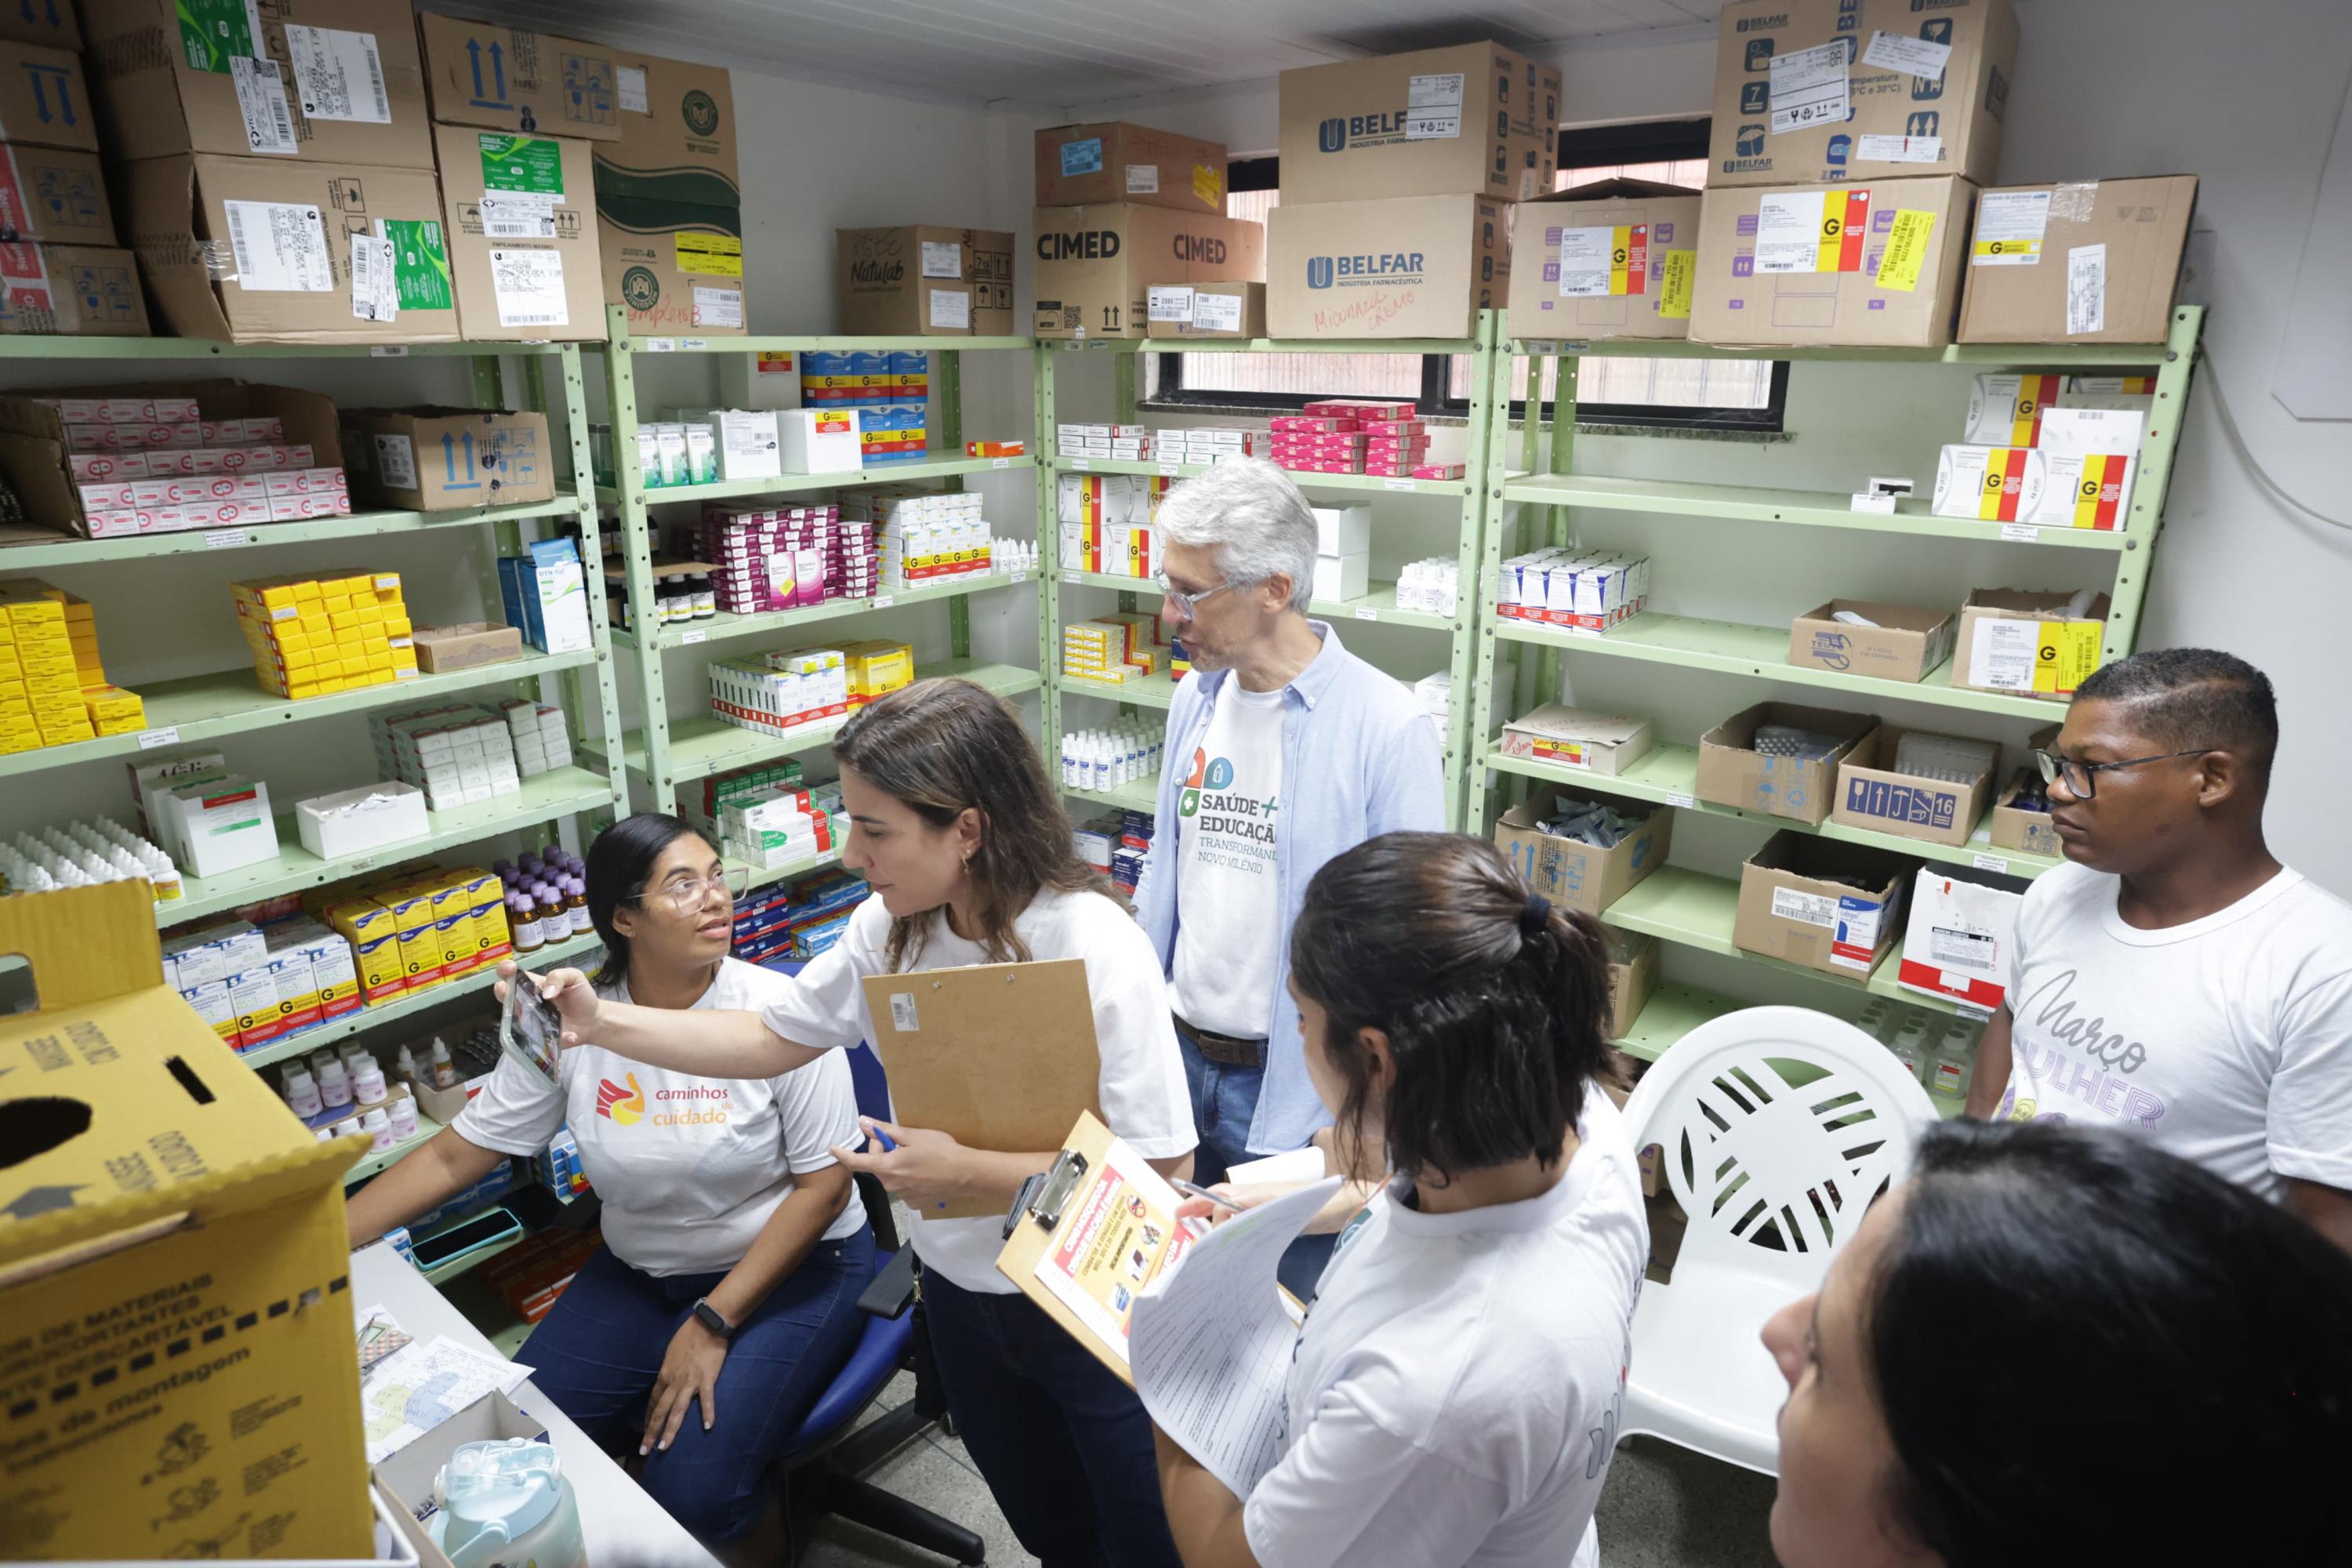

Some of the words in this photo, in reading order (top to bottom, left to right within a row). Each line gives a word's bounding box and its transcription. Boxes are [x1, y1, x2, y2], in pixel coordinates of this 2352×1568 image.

[1749, 14, 1788, 28] BELFAR
[1751, 85, 1759, 102] 7
[1349, 111, 1407, 136] BELF
[1736, 158, 1773, 169] BELFAR
[1824, 218, 1840, 235] G
[1036, 230, 1120, 261] CIMED
[1173, 234, 1227, 265] CIMED
[1991, 241, 2003, 254] G
[1613, 248, 1627, 263] G
[1337, 252, 1425, 275] BELFAR
[851, 260, 904, 284] Natulab
[1337, 278, 1371, 288] INDÚSTRIA
[1372, 275, 1424, 286] FARMACÊUTICA
[2019, 400, 2034, 415] G
[1987, 474, 2002, 488] G
[2082, 481, 2098, 495] G
[1083, 492, 1091, 503] G
[1083, 541, 1091, 550] G
[1131, 545, 1138, 555] G
[933, 554, 941, 564] G
[953, 552, 961, 562] G
[971, 549, 979, 558] G
[910, 557, 918, 568] G
[2039, 644, 2056, 661] G
[1202, 792, 1259, 817] SAÚDE
[1936, 797, 1954, 815] 16
[1199, 815, 1277, 845] EDUCAÇÃ
[1199, 837, 1279, 861] TRANSFORMAND
[1198, 851, 1226, 866] NOVO
[1226, 856, 1263, 875] MILÊNIO
[480, 937, 490, 948] G
[445, 950, 456, 961] G
[408, 962, 419, 974] G
[369, 974, 381, 985] G
[321, 988, 335, 1001] G
[279, 1001, 294, 1014] G
[239, 1015, 254, 1029] G
[2014, 969, 2147, 1074] Março
[655, 1084, 728, 1101] caminhos
[2026, 1040, 2165, 1131] ULHER
[721, 1101, 734, 1110] do
[652, 1106, 728, 1127] cuidado
[85, 1272, 213, 1329] MATERIAIS
[106, 1347, 251, 1414] montagem
